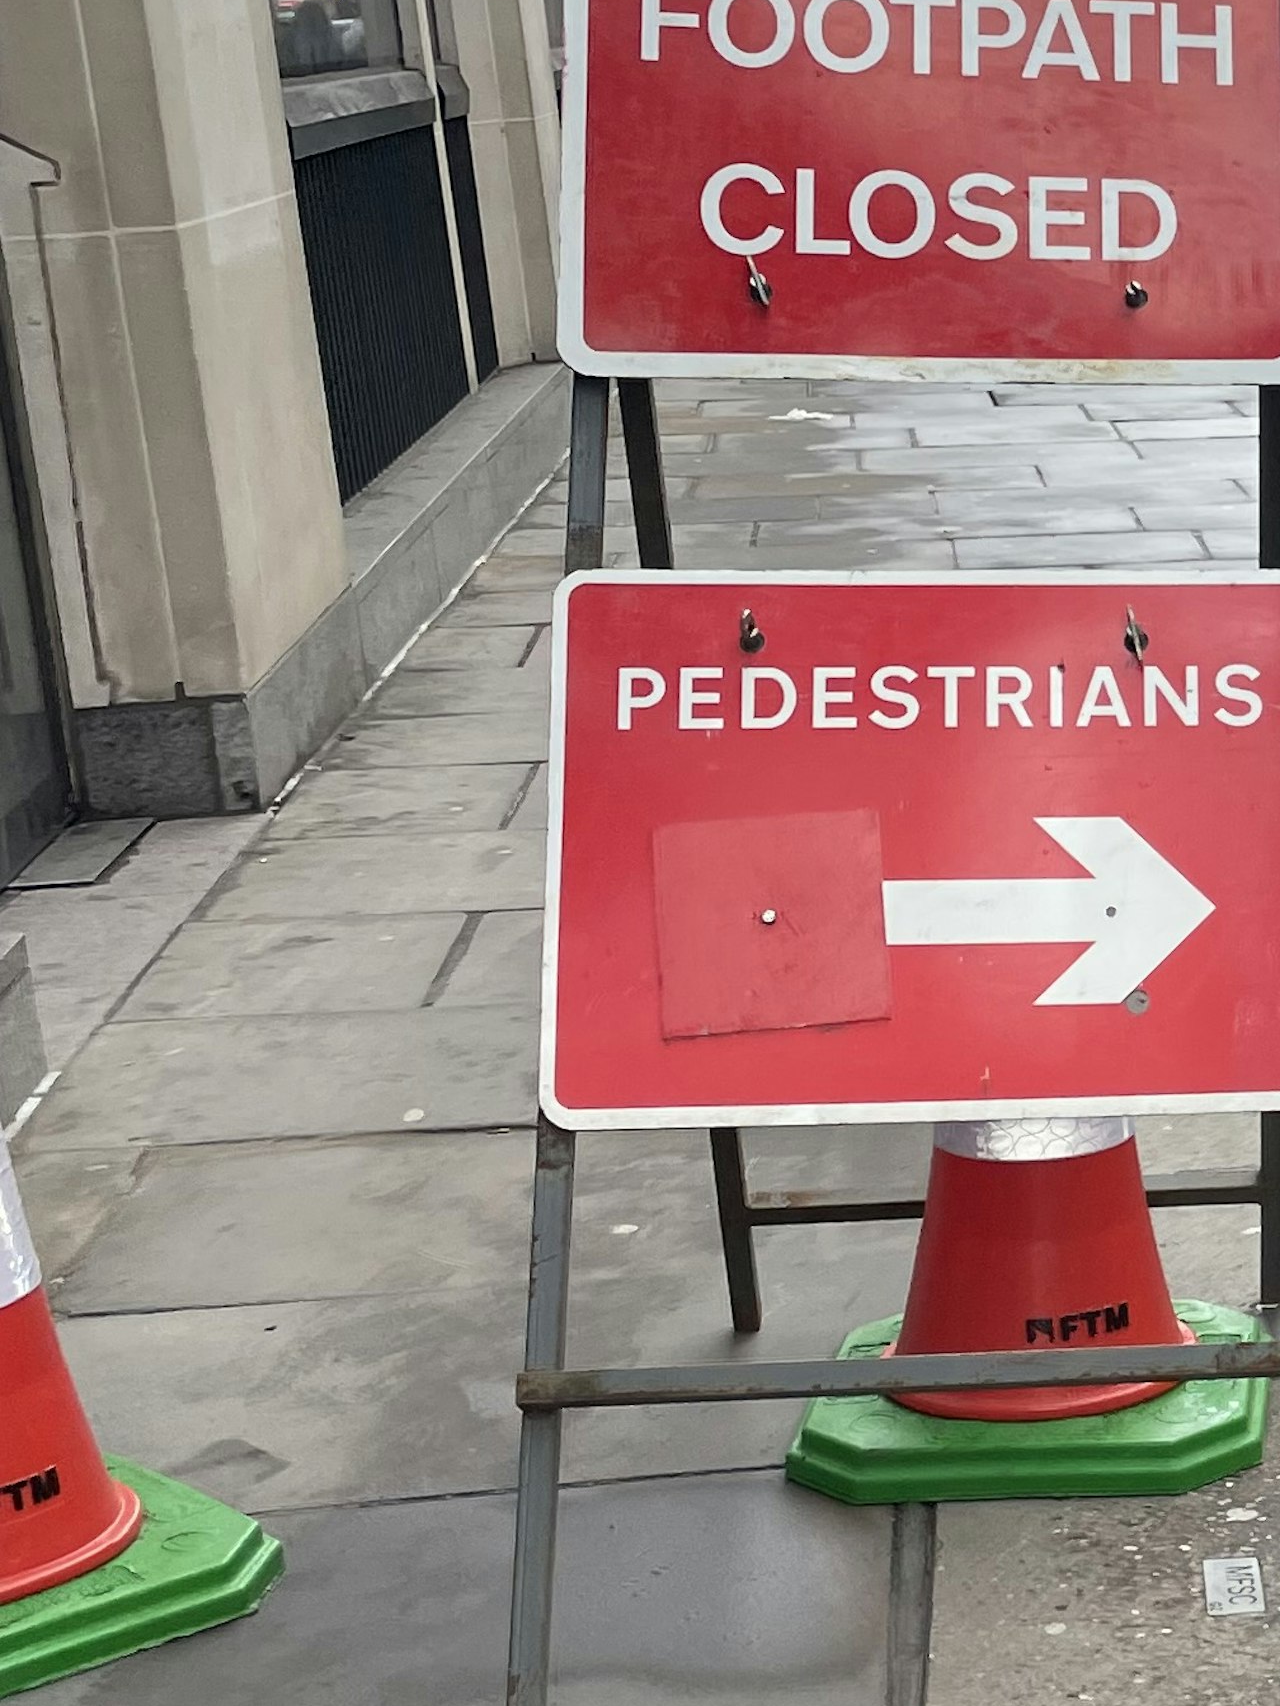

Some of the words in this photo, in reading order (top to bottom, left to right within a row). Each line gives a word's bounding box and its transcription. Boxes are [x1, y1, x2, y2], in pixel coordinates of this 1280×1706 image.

[699, 162, 1178, 262] CLOSED
[617, 664, 1264, 731] PEDESTRIANS
[1060, 1302, 1130, 1342] FTM
[0, 1465, 61, 1511] TM
[1225, 1565, 1258, 1605] MFSC
